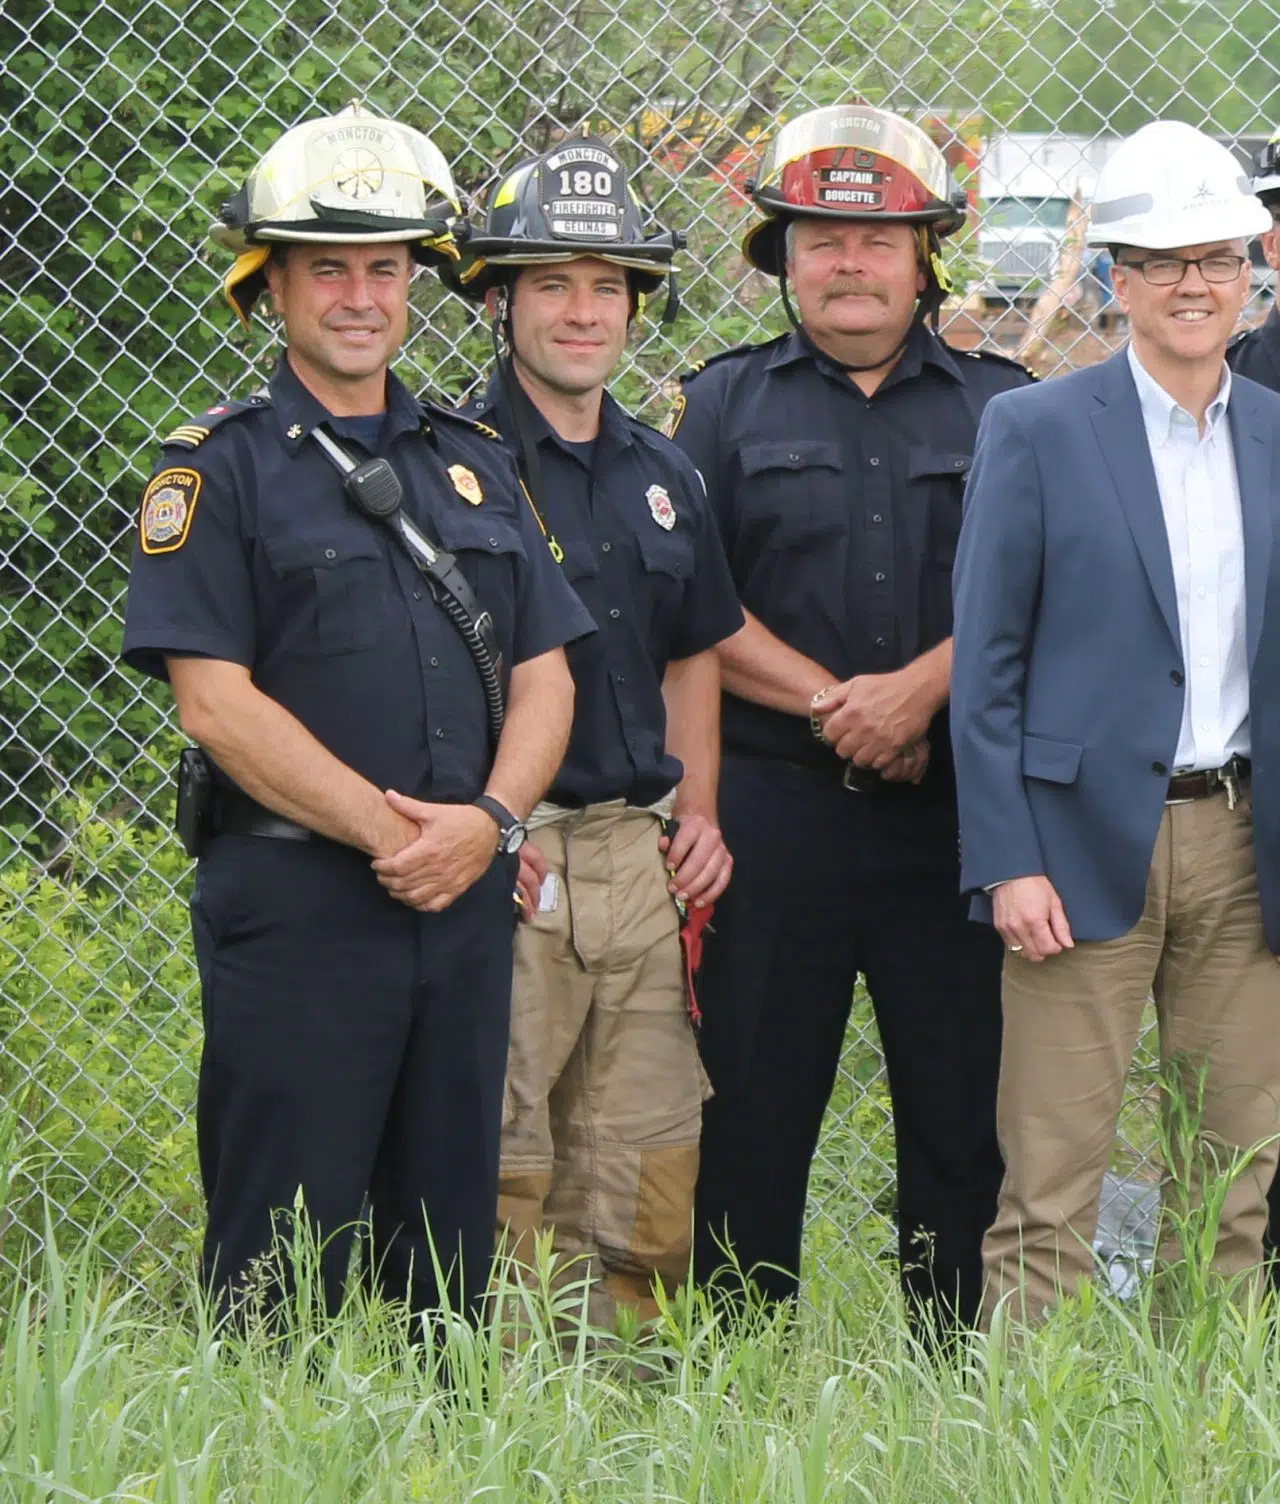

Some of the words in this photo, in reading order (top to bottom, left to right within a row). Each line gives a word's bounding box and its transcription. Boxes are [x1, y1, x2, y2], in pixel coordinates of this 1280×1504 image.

[326, 126, 384, 146] MONCTON
[558, 148, 610, 165] MONCTON
[560, 170, 612, 196] 180
[829, 170, 874, 184] CAPTAIN
[825, 189, 875, 204] DOUCETTE
[552, 202, 617, 218] FIREFIGHTER
[563, 220, 607, 234] GELINAS
